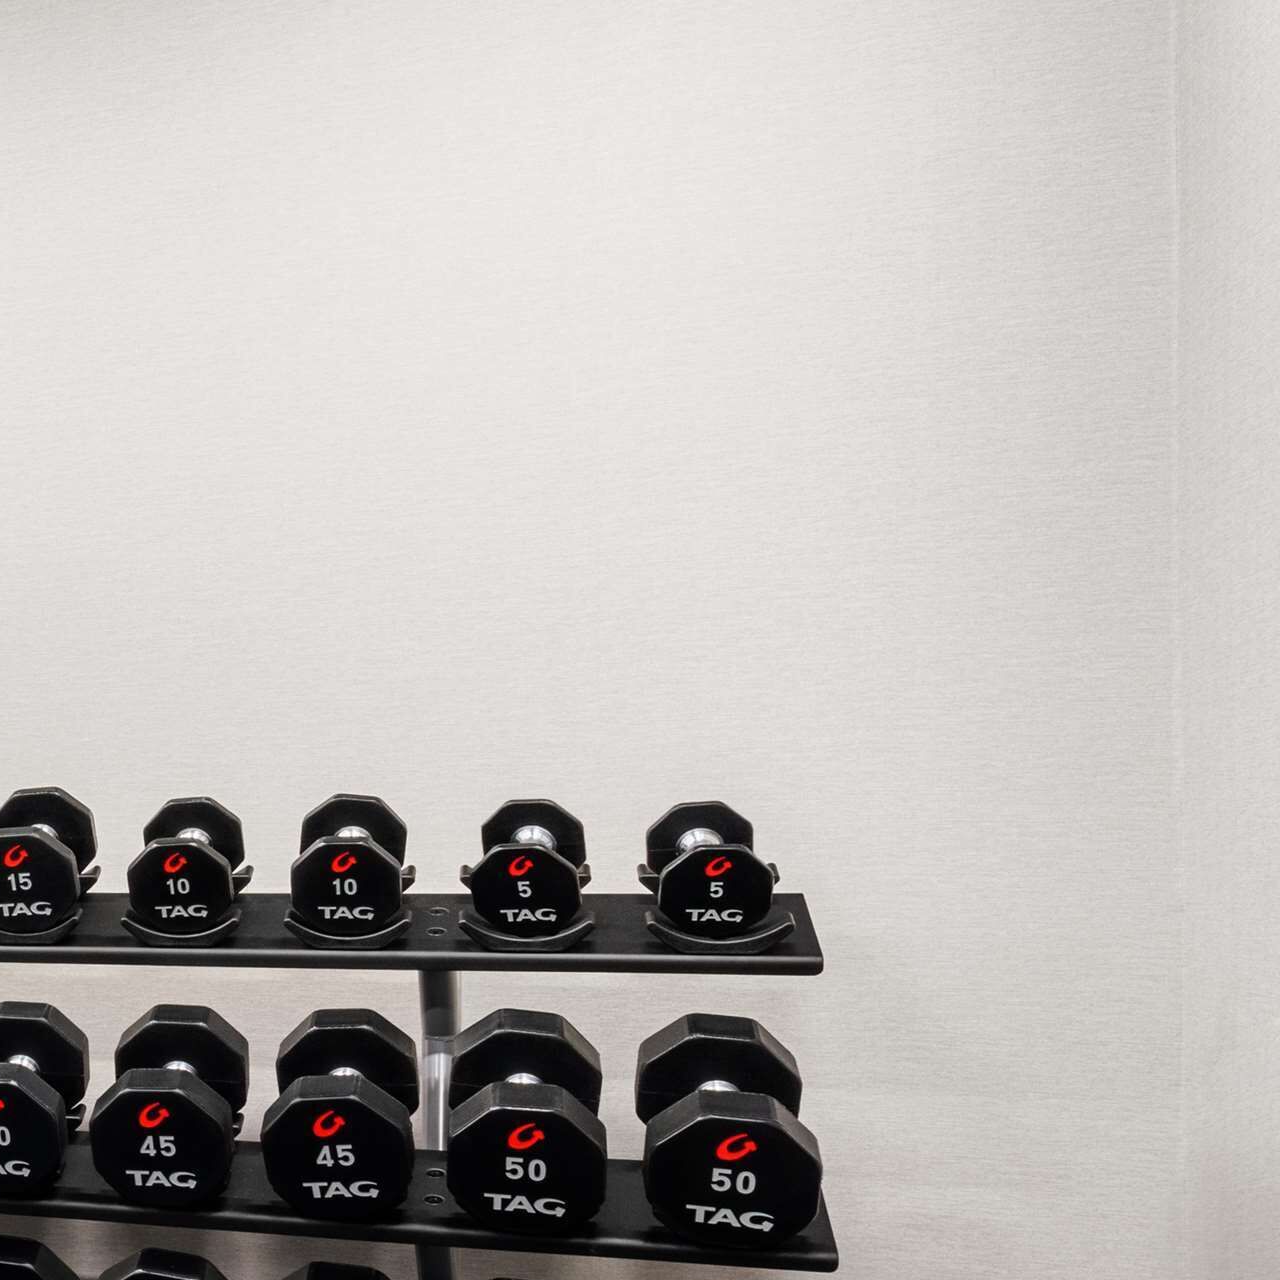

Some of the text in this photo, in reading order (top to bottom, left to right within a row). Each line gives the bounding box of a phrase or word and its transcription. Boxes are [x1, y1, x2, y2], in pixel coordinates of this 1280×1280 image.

[7, 872, 33, 891] 15
[166, 878, 190, 895] 10
[332, 878, 358, 896] 10
[517, 880, 532, 898] 5
[709, 881, 724, 898] 5
[154, 904, 208, 918] TAG
[317, 906, 375, 921] TAG
[499, 908, 557, 922] TAG
[685, 909, 743, 923] TAG
[140, 1135, 176, 1157] 45
[316, 1144, 355, 1167] 45
[505, 1156, 546, 1182] 50
[125, 1170, 197, 1189] TAG
[710, 1167, 756, 1195] 50
[302, 1181, 379, 1198] TAG
[483, 1192, 566, 1217] TAG
[685, 1204, 774, 1232] TAG
